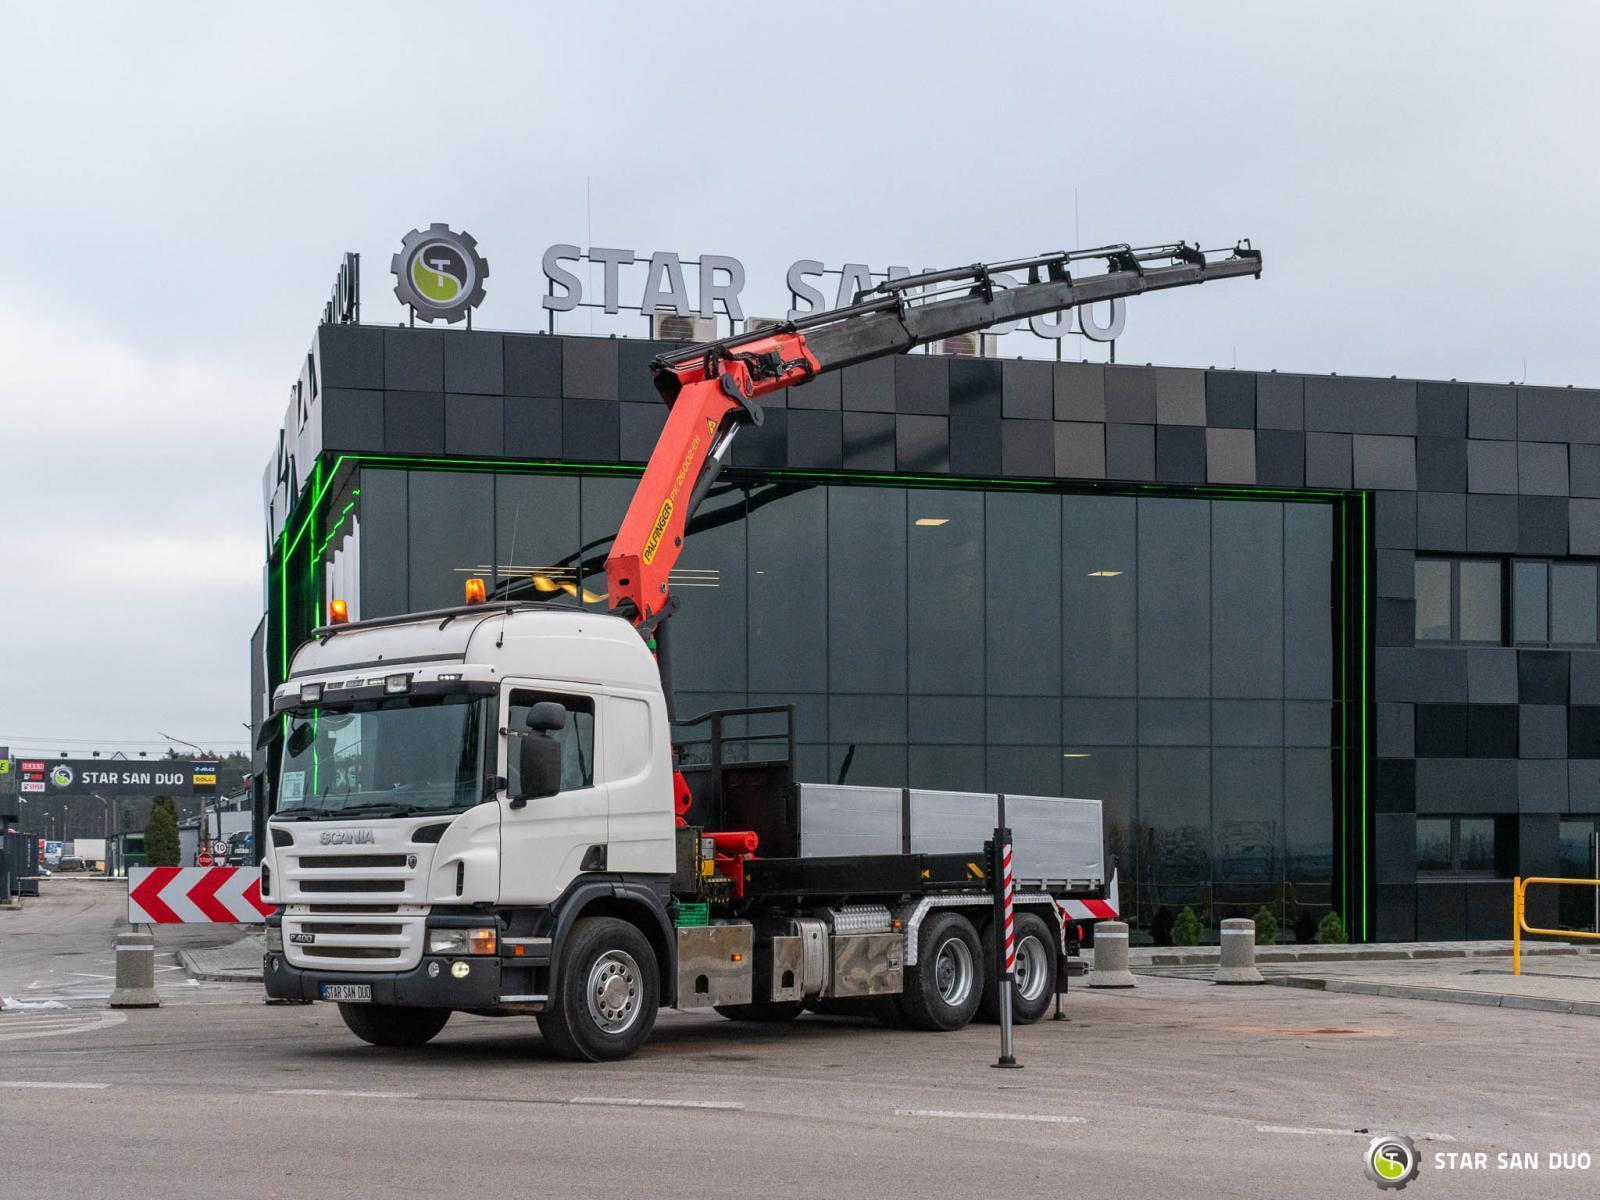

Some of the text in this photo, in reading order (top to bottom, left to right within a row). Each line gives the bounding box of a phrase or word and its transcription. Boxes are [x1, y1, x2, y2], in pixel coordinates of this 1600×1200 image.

[542, 244, 746, 321] STAR
[644, 502, 673, 562] PALFINGER
[82, 772, 184, 785] STAR SAN DUO
[320, 829, 375, 845] SCANIA
[216, 844, 225, 852] 10
[326, 986, 371, 999] STAR SAN DUO
